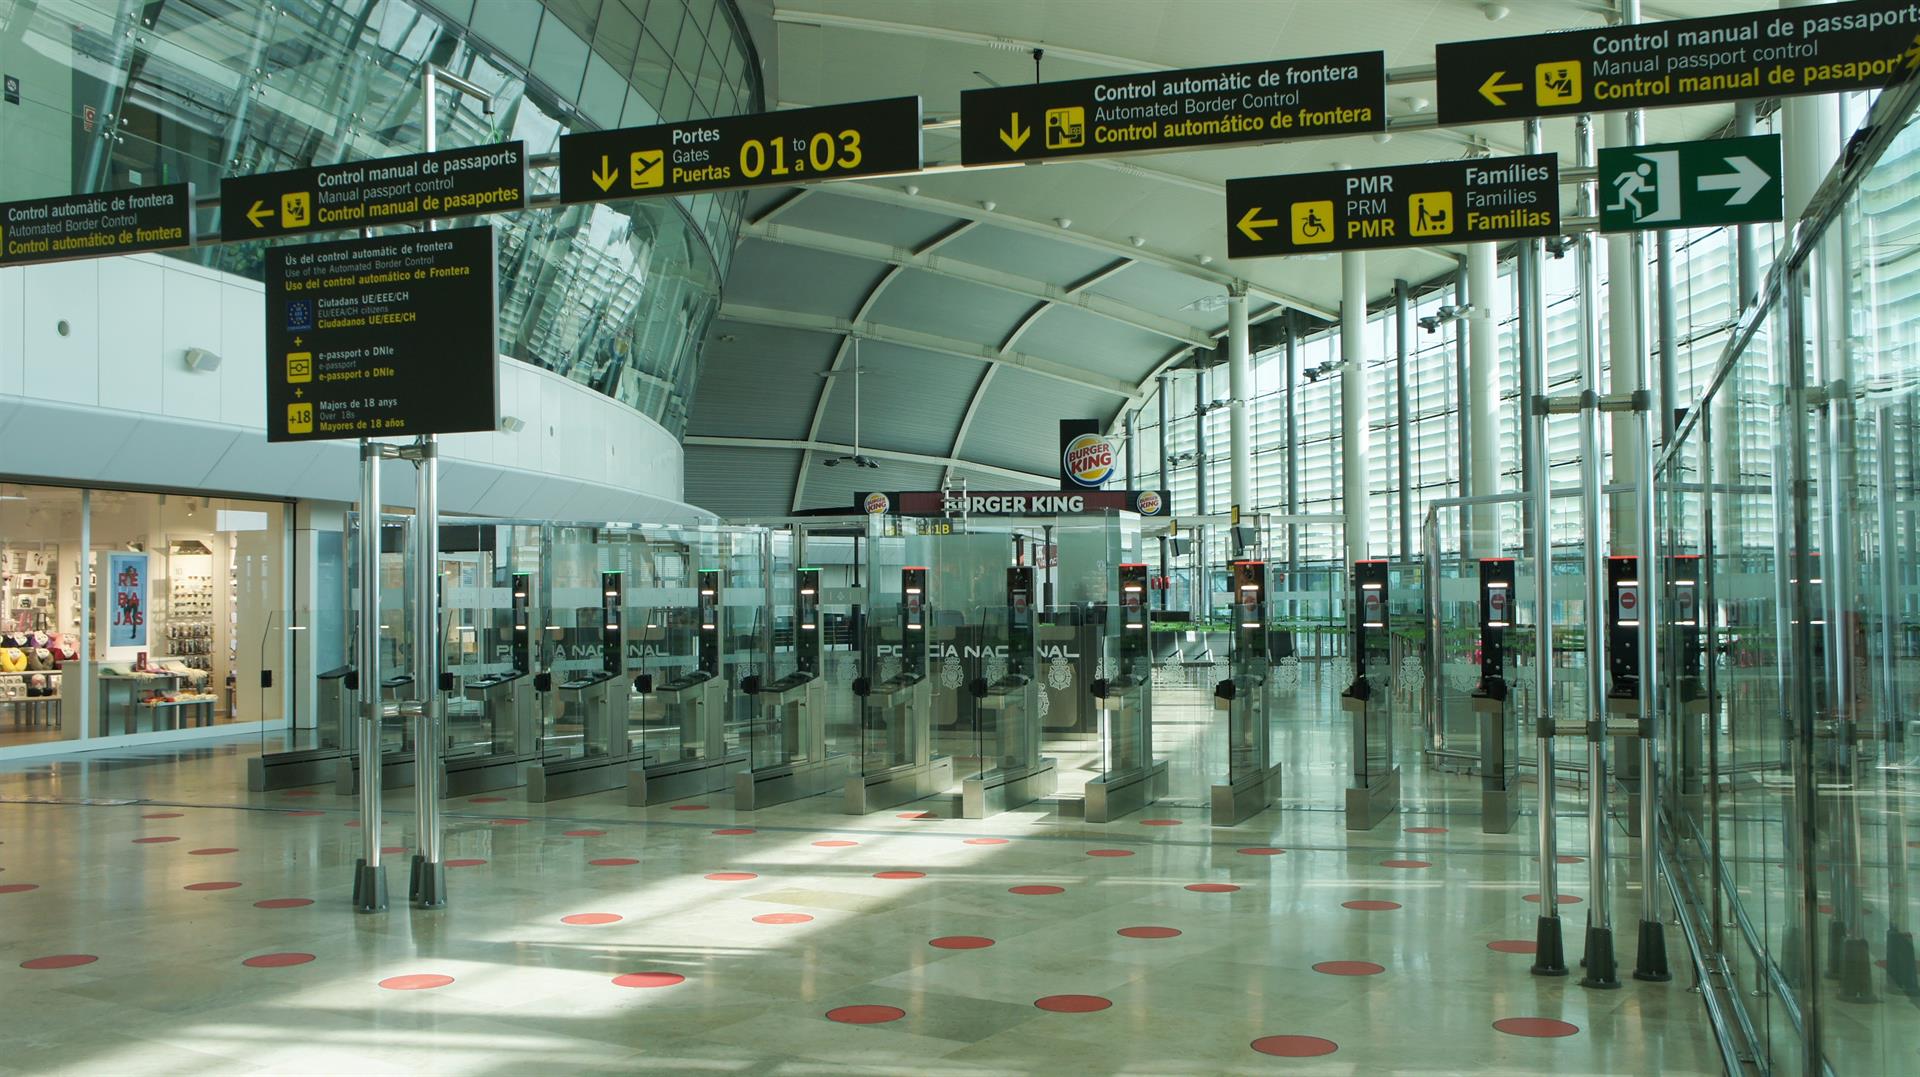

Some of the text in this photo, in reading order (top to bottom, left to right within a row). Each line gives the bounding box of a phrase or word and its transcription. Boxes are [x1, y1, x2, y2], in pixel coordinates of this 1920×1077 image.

[1593, 4, 1920, 55] Control manual de passaport
[1593, 39, 1818, 77] Manual passport control
[1094, 65, 1358, 102] Control automàtic de frontera
[1594, 75, 1670, 100] Control
[1679, 66, 1759, 93] manual
[1767, 64, 1795, 84] de
[1094, 89, 1299, 122] Automated Border Control
[1094, 107, 1372, 143] Control automático de frontera
[672, 128, 720, 146] Portes
[673, 148, 710, 164] Gates
[739, 129, 862, 178] 01 to a 03
[318, 150, 517, 187] Control manual de passaports
[672, 165, 731, 184] Puertas
[1466, 163, 1550, 186] Famílies
[318, 175, 454, 204] Manual passport control
[1346, 174, 1394, 195] PMR
[8, 193, 174, 221] Control automàtic de frontera
[318, 187, 519, 223] Control manual de pasaportes
[1347, 198, 1387, 216] PRM
[1466, 188, 1537, 208] Families
[8, 212, 138, 238] Automated Border Control
[1347, 218, 1395, 239] PMR
[1467, 208, 1551, 231] Familias
[8, 226, 182, 255] Control automático de frontera
[300, 255, 314, 265] del
[317, 250, 349, 263] control
[401, 244, 413, 254] de
[416, 240, 453, 252] frontera
[285, 255, 435, 278] Use of the Automated Border Control
[285, 265, 470, 291] Uso del control automático de Frontera
[318, 291, 409, 308] Ciutadans UE/EEE/CH
[361, 305, 389, 314] citizens
[318, 317, 366, 329] Ciudadanos
[369, 312, 416, 325] UE/EEE/CH
[318, 348, 361, 361] e-passport
[318, 360, 357, 371] e-passport
[318, 370, 362, 383] e-passport
[364, 370, 370, 378] o
[319, 397, 398, 411] Majors de 18 anys
[289, 410, 312, 424] +18
[319, 411, 336, 420] Over
[319, 418, 405, 432] Mayores de 18 años
[1069, 443, 1109, 462] BURGER
[1071, 452, 1112, 475] KING
[945, 495, 1084, 513] BURGER KING
[114, 611, 144, 626] JAS
